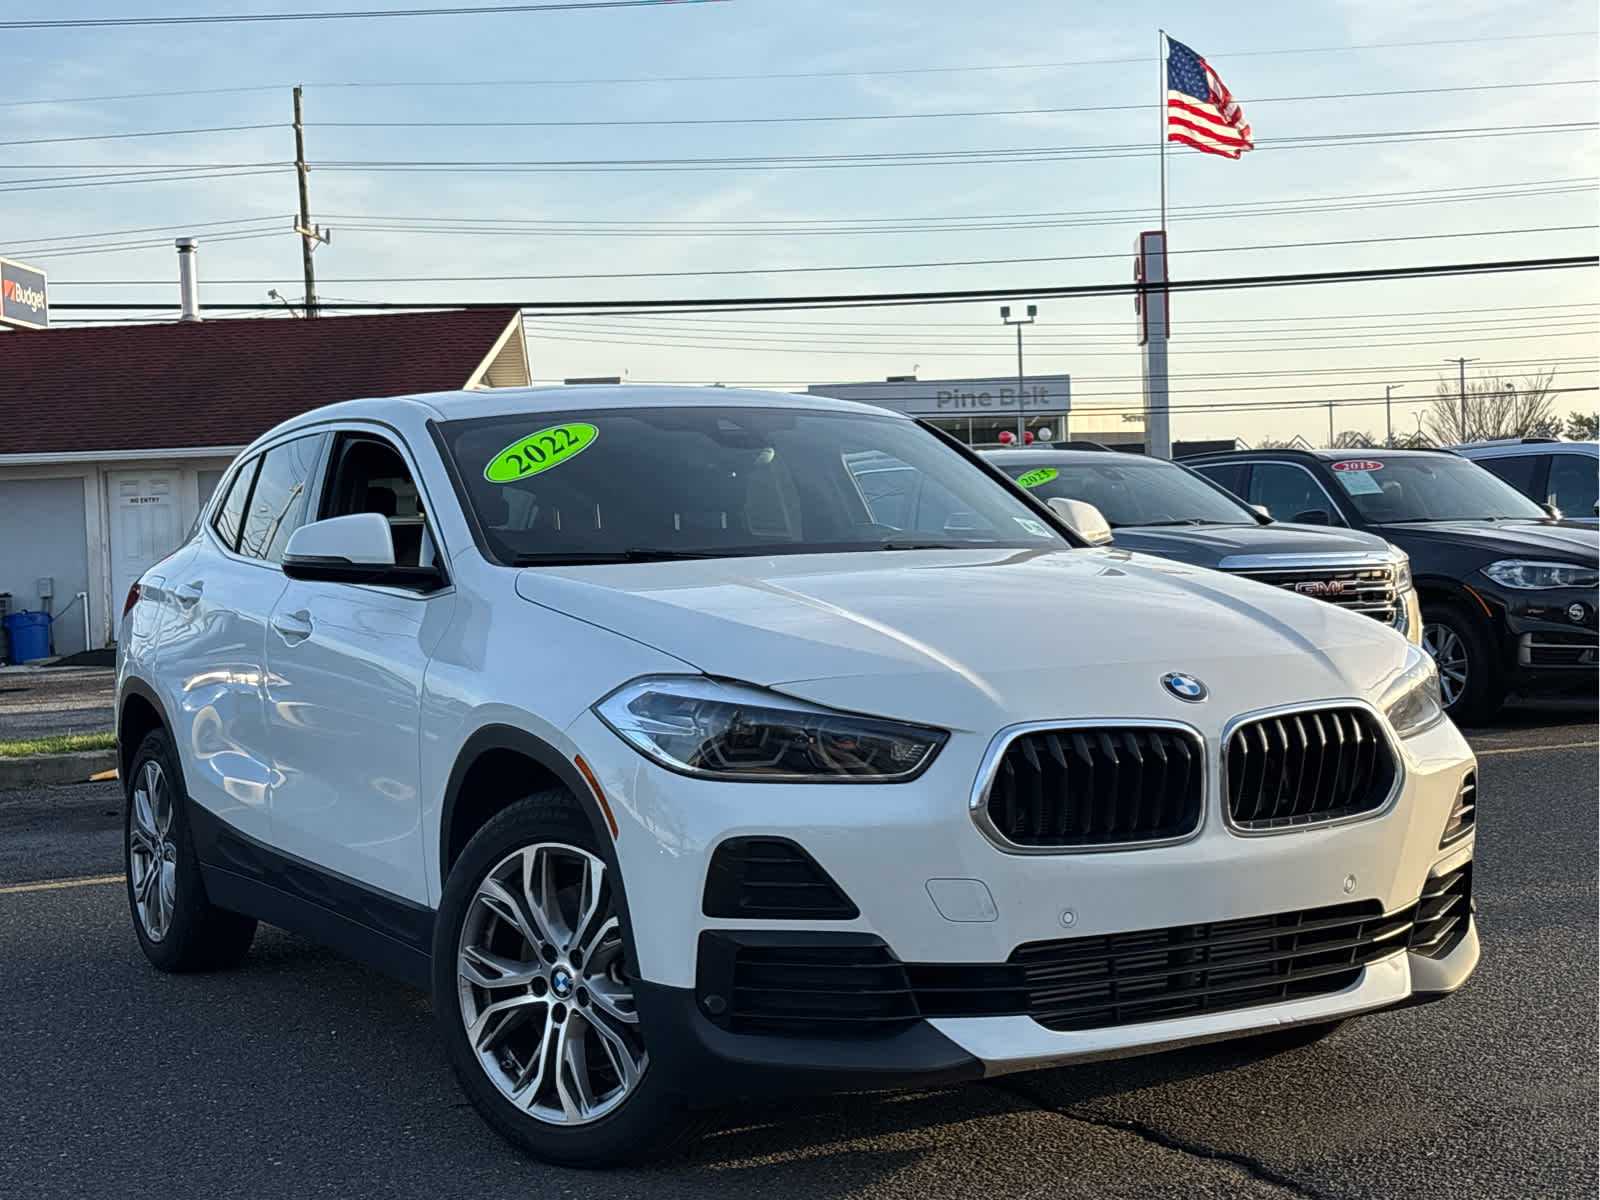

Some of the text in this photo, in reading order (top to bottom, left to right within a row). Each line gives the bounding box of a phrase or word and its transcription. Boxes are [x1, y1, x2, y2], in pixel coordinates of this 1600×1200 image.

[15, 282, 45, 312] Budget
[936, 386, 1049, 408] Pine Belt
[505, 428, 580, 474] 2022
[1343, 462, 1375, 471] 2015
[140, 496, 160, 504] ENTRY
[1295, 581, 1357, 596] GMC
